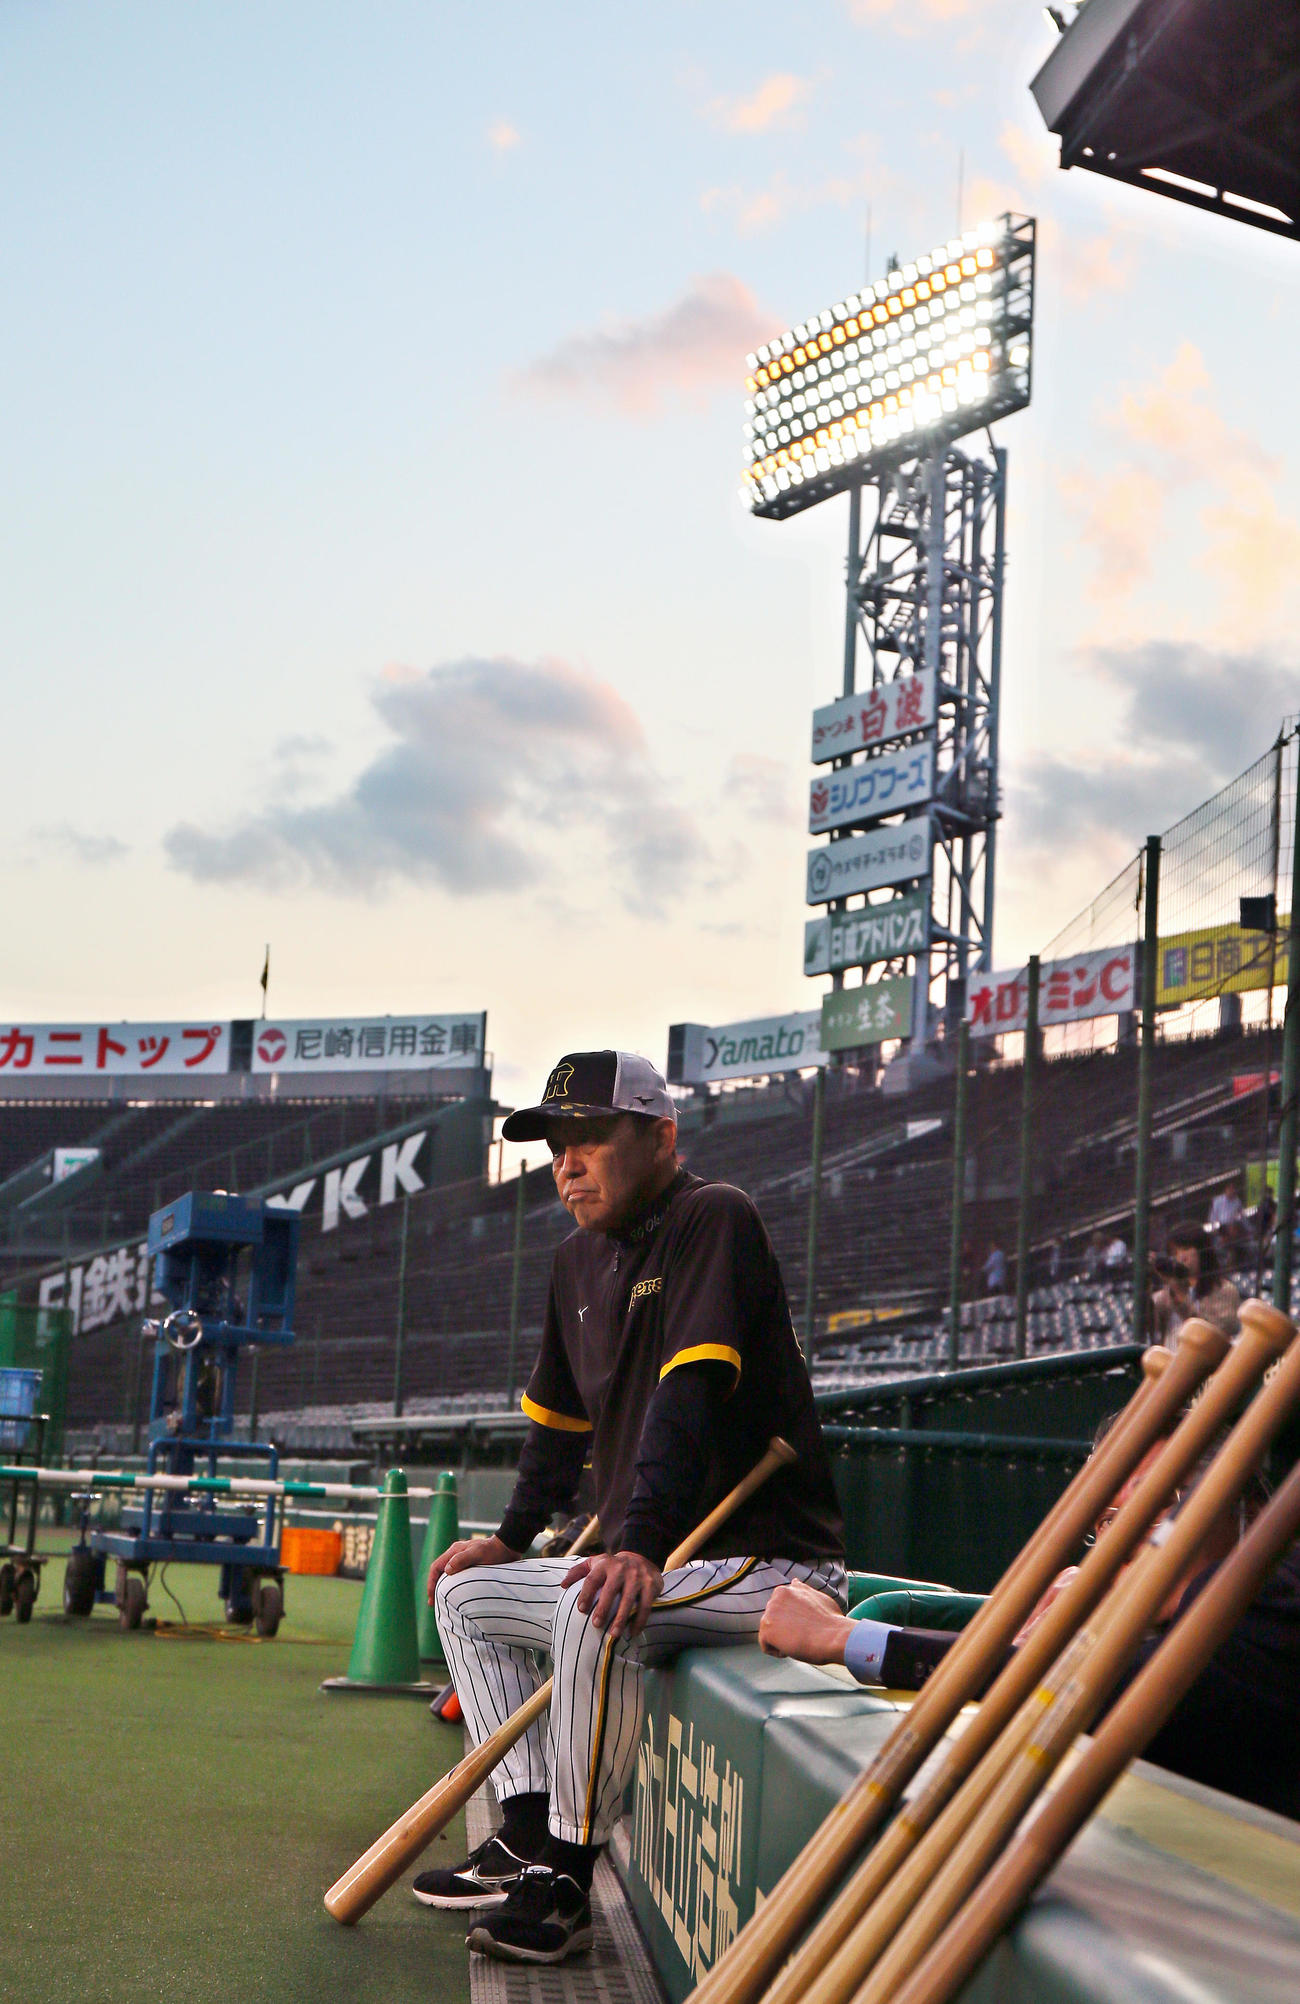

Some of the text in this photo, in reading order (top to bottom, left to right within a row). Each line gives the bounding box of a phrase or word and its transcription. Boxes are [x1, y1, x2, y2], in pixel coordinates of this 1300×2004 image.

[0, 1025, 222, 1069] カニトップ
[293, 1022, 478, 1060] 尼崎信用金庫
[704, 1026, 805, 1069] Yamato
